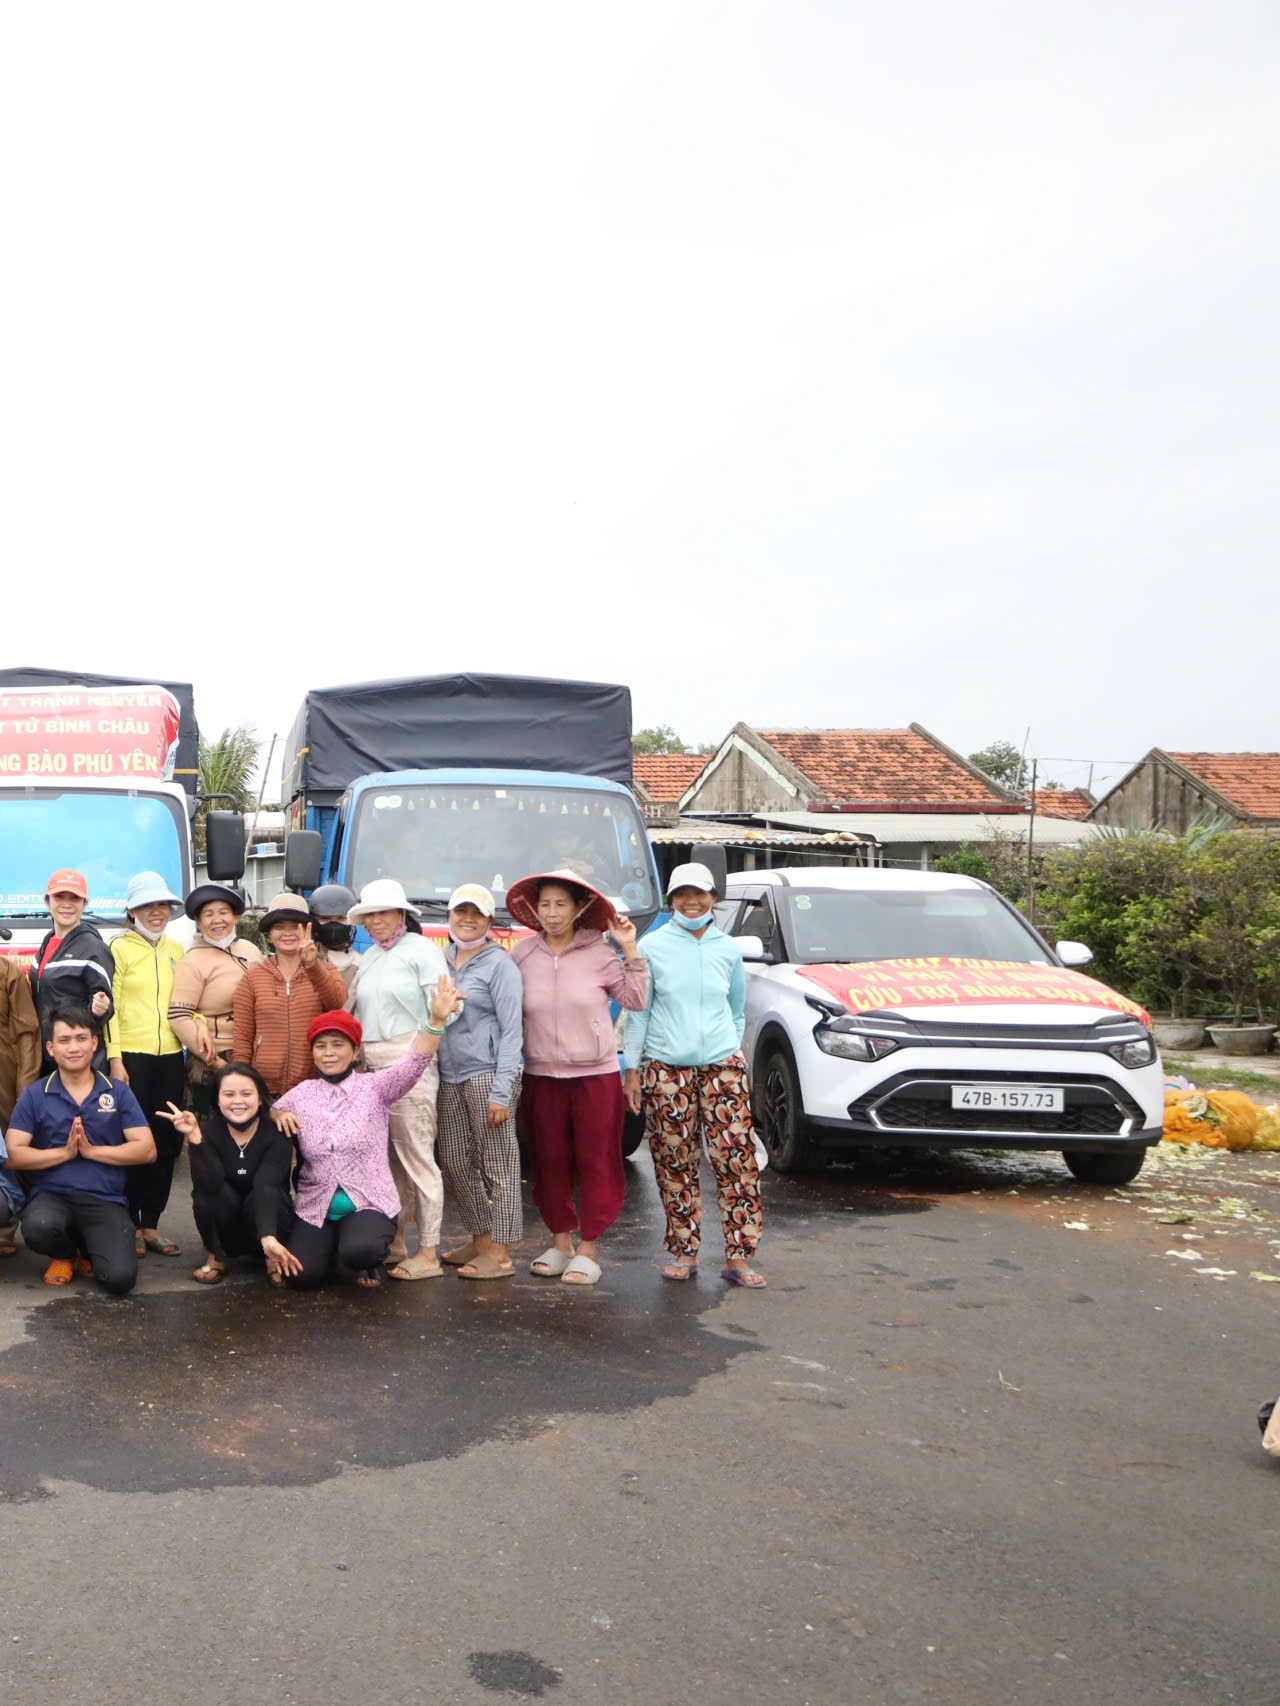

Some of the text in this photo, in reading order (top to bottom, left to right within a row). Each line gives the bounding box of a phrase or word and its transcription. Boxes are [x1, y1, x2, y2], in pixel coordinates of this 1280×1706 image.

[45, 717, 91, 733] BÌNH
[97, 717, 150, 735] CHÂU
[27, 748, 67, 773] BÀO
[73, 748, 113, 774] PHÚ
[120, 747, 158, 774] YÊN
[848, 984, 903, 1011] CỨU
[902, 983, 960, 1005] TRỢ
[962, 1090, 1054, 1108] 47B-157.73
